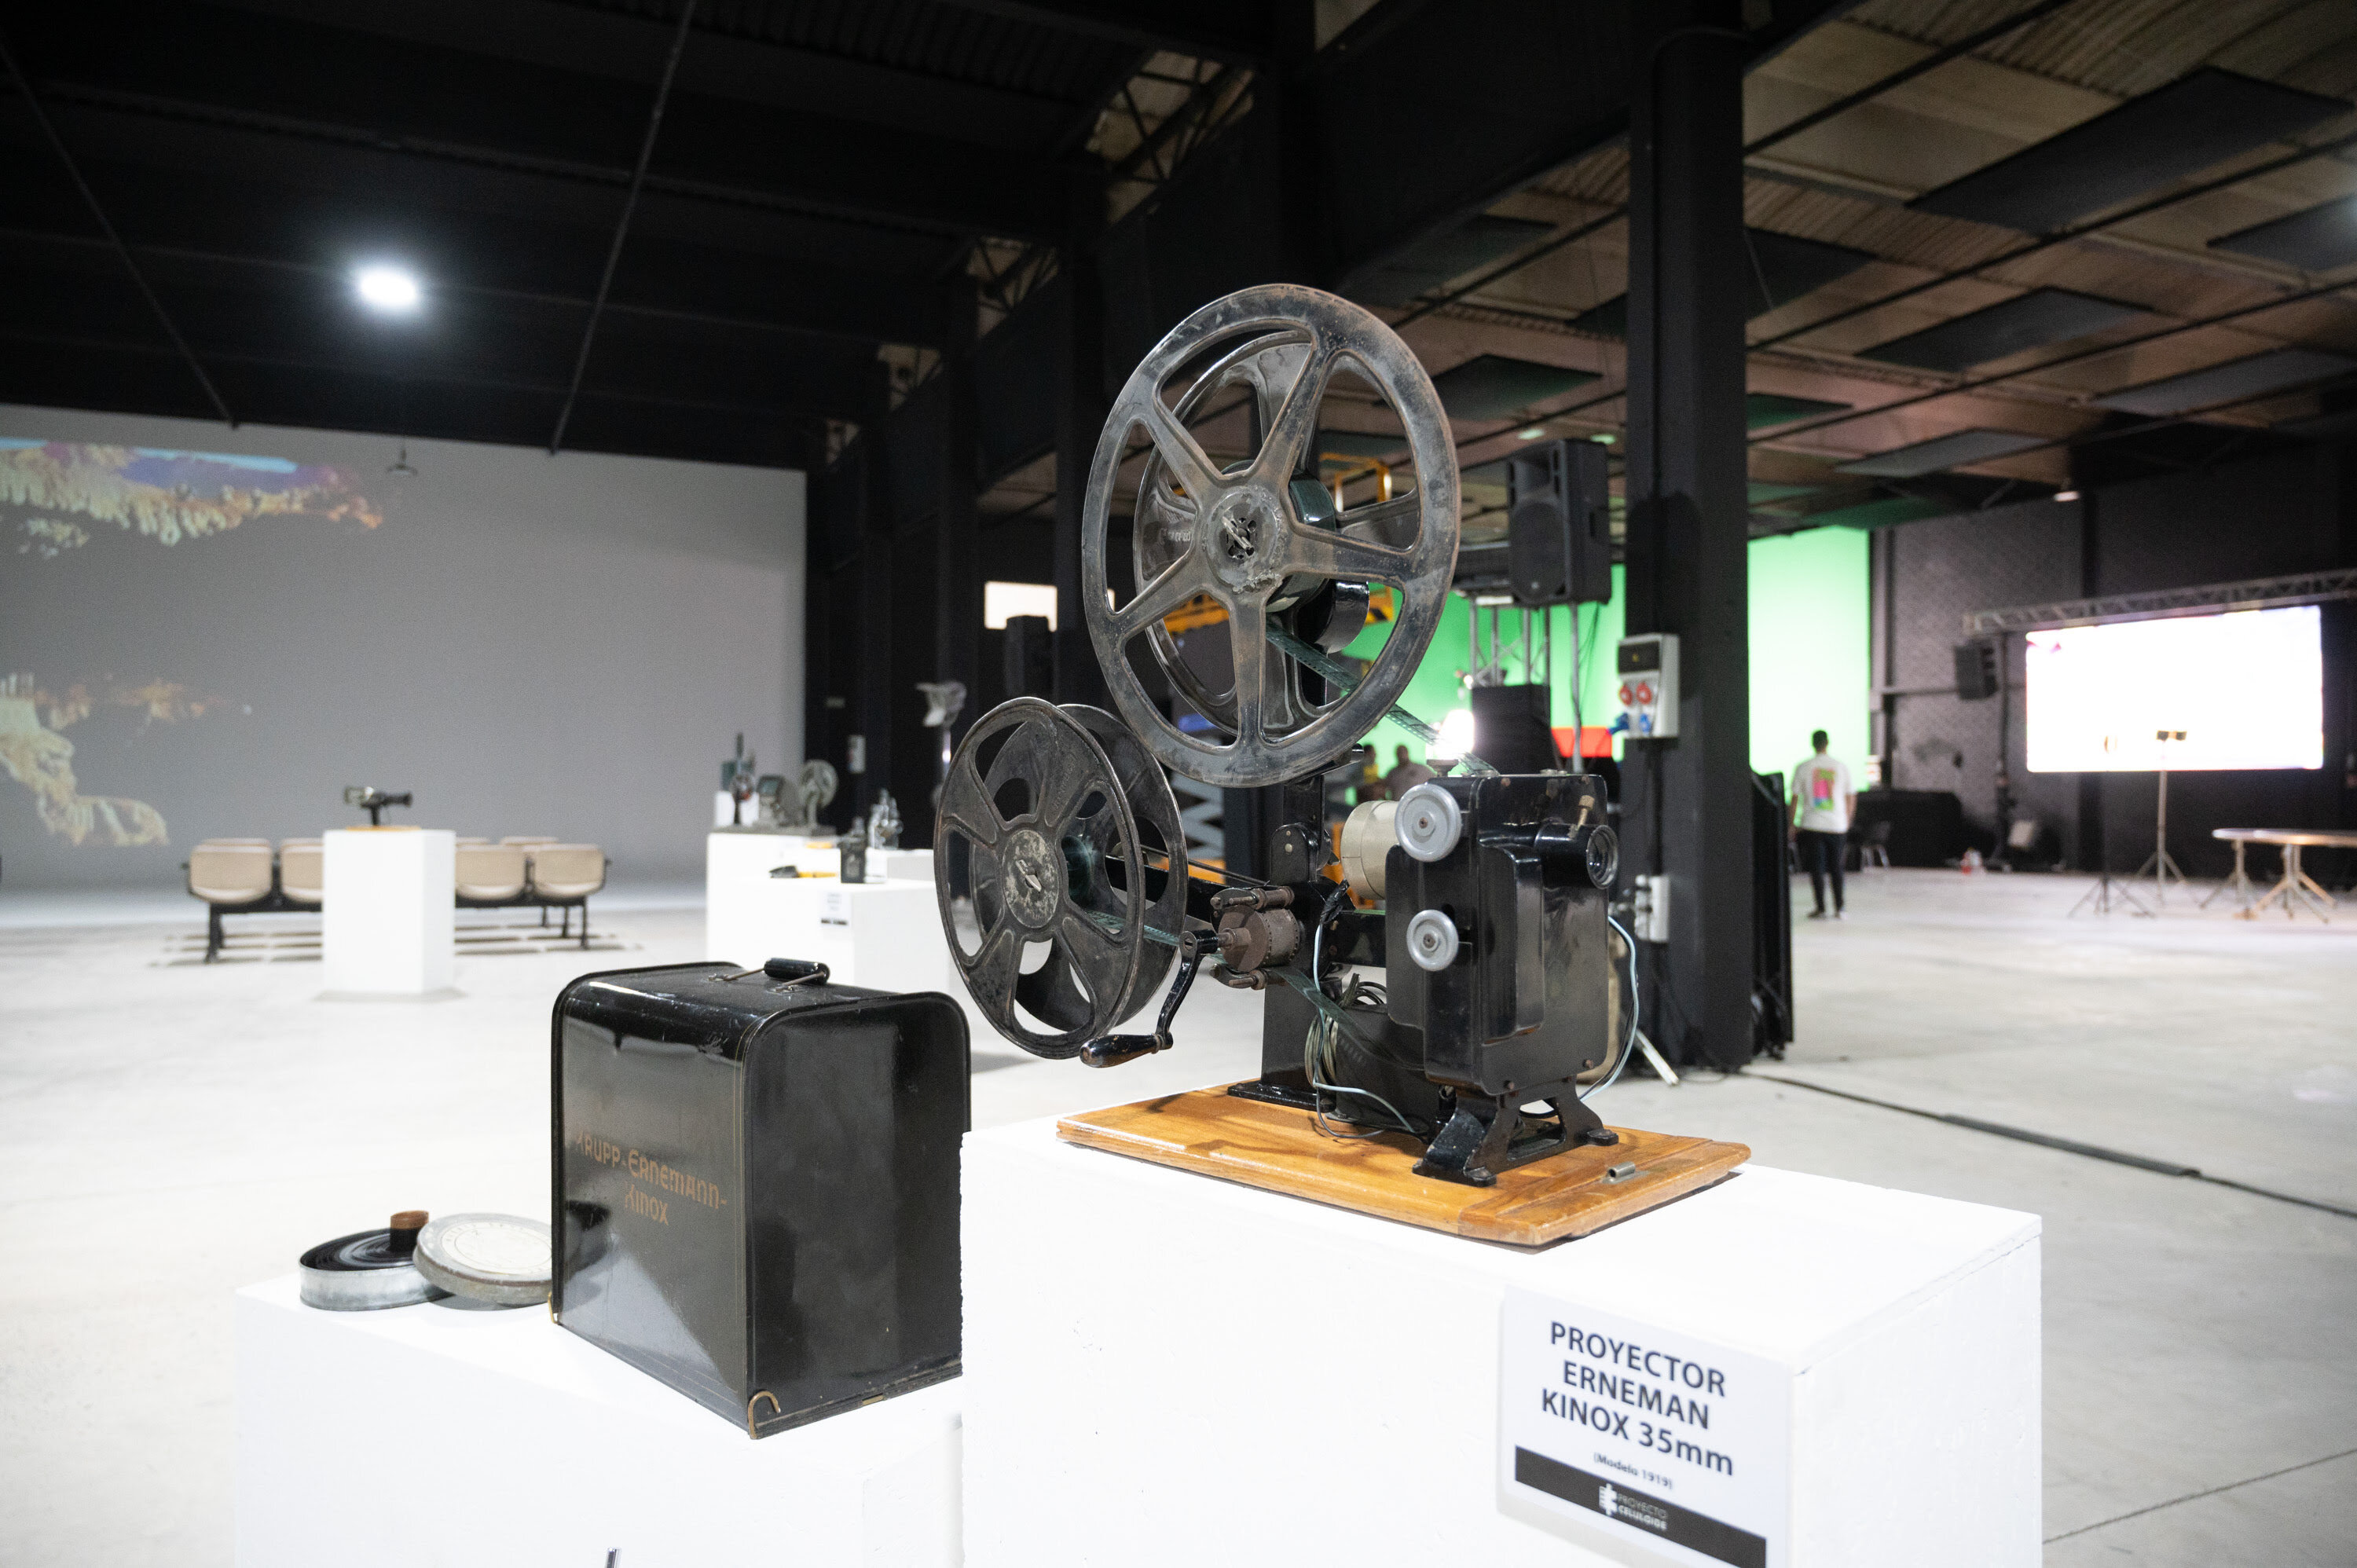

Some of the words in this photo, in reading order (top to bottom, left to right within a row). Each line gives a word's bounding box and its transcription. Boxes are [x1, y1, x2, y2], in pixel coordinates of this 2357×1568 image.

[1551, 1321, 1725, 1397] PROYECTOR
[1563, 1360, 1709, 1429] ERNEMAN
[1542, 1388, 1630, 1441] KINOX
[1638, 1421, 1733, 1476] 35mm
[1593, 1452, 1638, 1476] (Modelo
[1642, 1469, 1673, 1489] 1919)
[1618, 1493, 1668, 1520] PROYECTO
